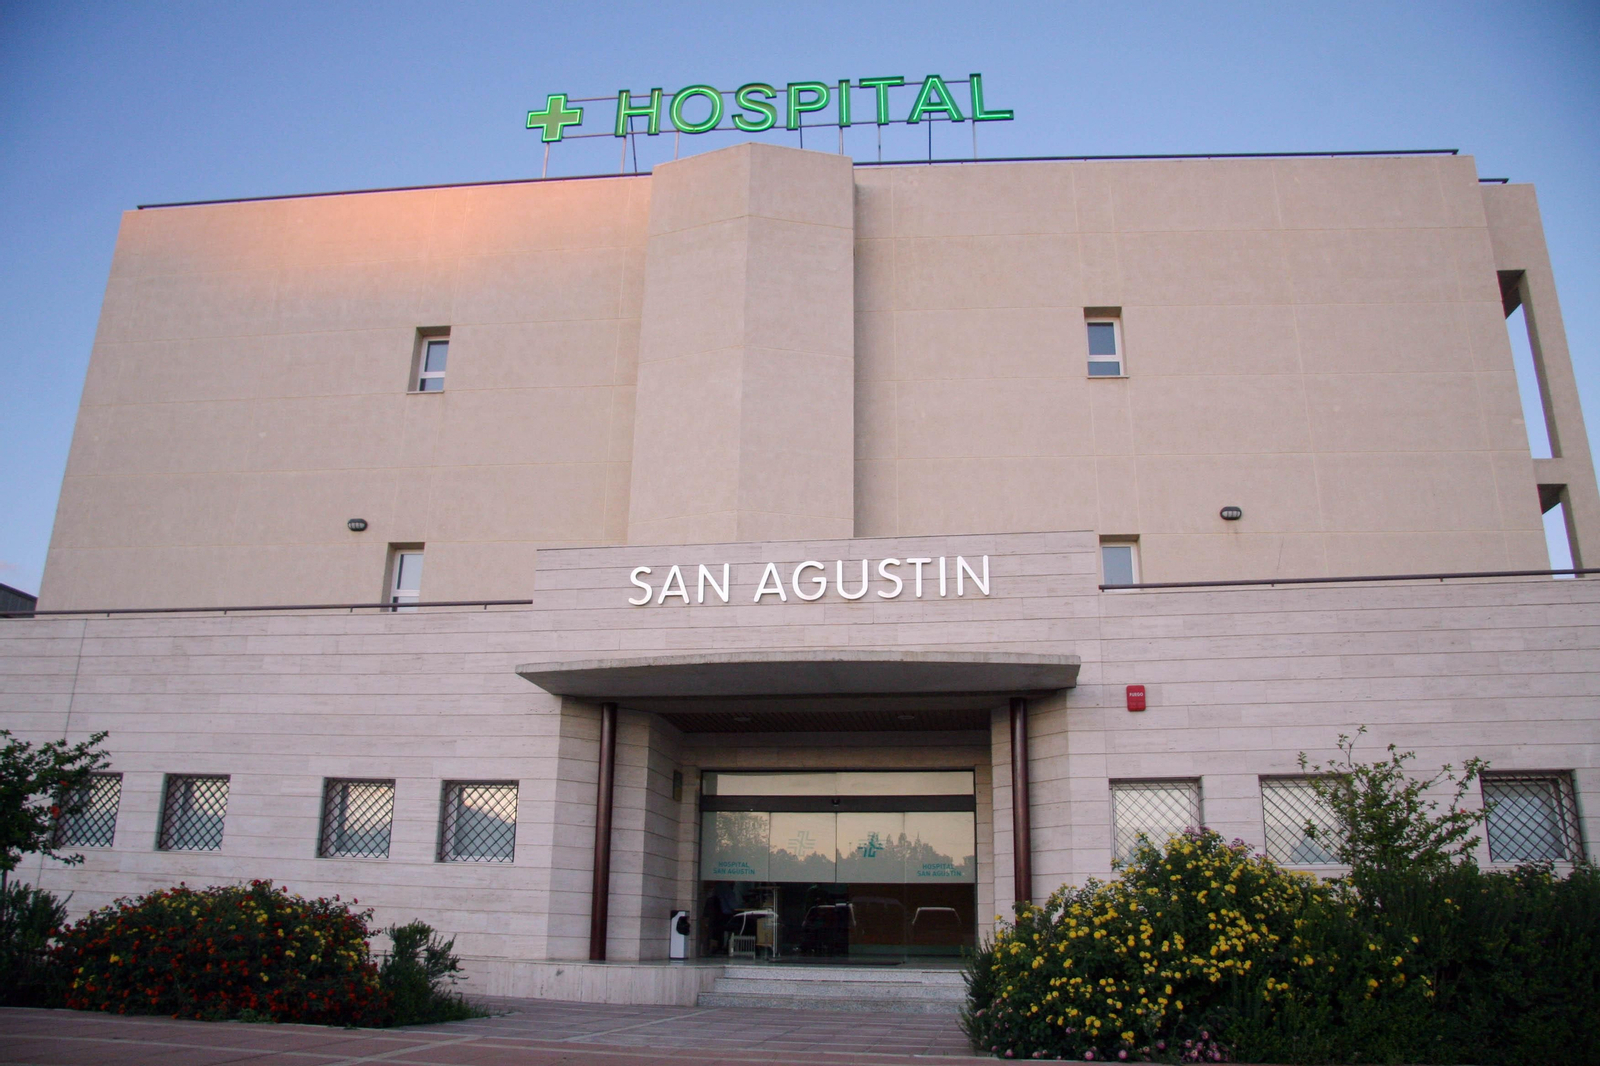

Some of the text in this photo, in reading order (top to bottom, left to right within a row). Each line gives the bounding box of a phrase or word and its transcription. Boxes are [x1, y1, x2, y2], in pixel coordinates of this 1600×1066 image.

[614, 73, 1014, 138] HOSPITAL
[627, 554, 991, 607] SAN AGUSTIN
